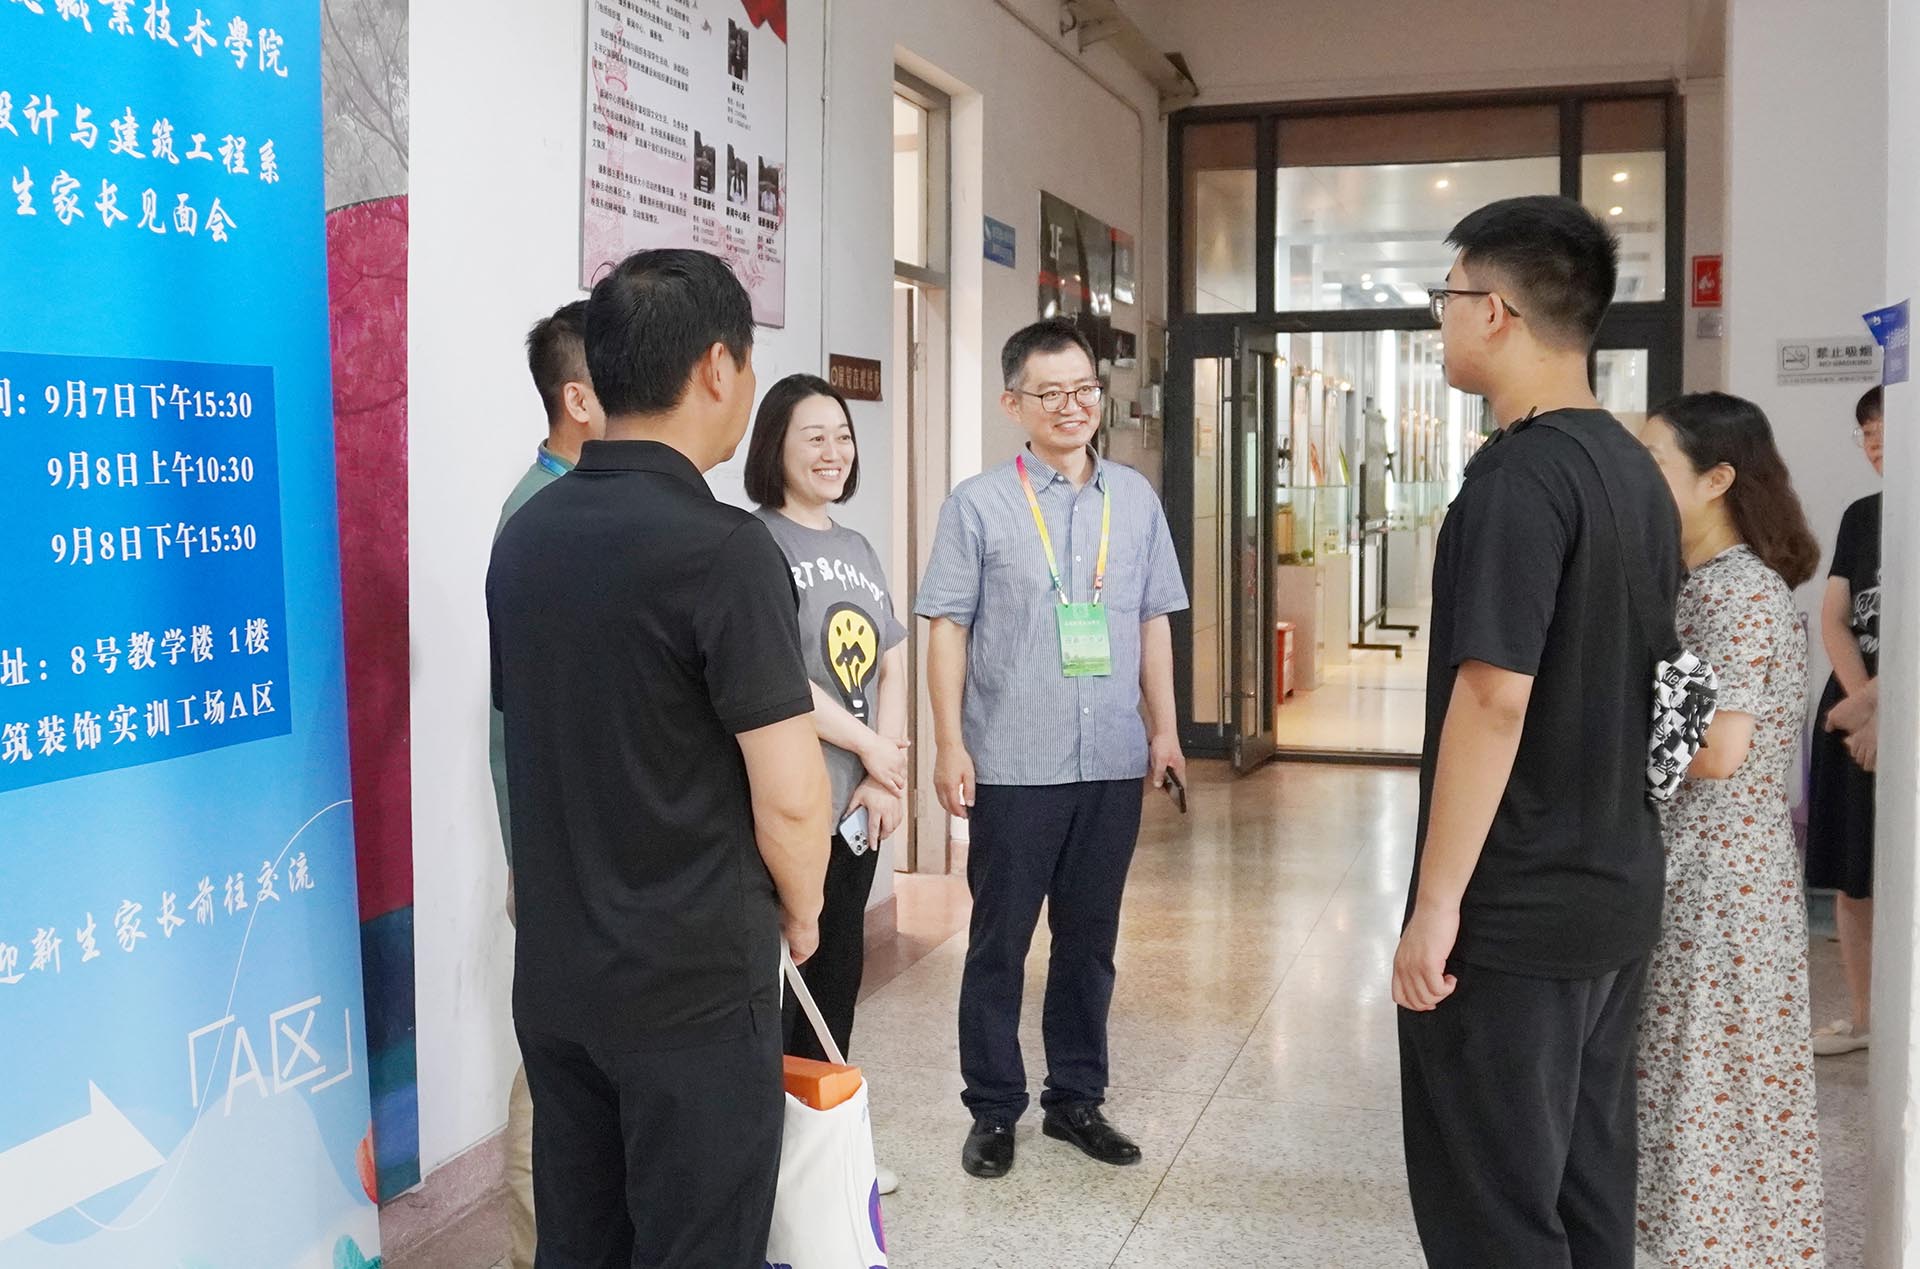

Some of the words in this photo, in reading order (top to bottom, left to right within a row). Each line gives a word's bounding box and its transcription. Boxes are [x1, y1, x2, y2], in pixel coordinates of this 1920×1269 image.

[11, 166, 238, 243] 生家长见面会
[48, 451, 255, 491] 9月8日上午10:30
[52, 523, 257, 566] 9月8日下午15:30
[2, 680, 276, 763] 筑装饰实训工场A区
